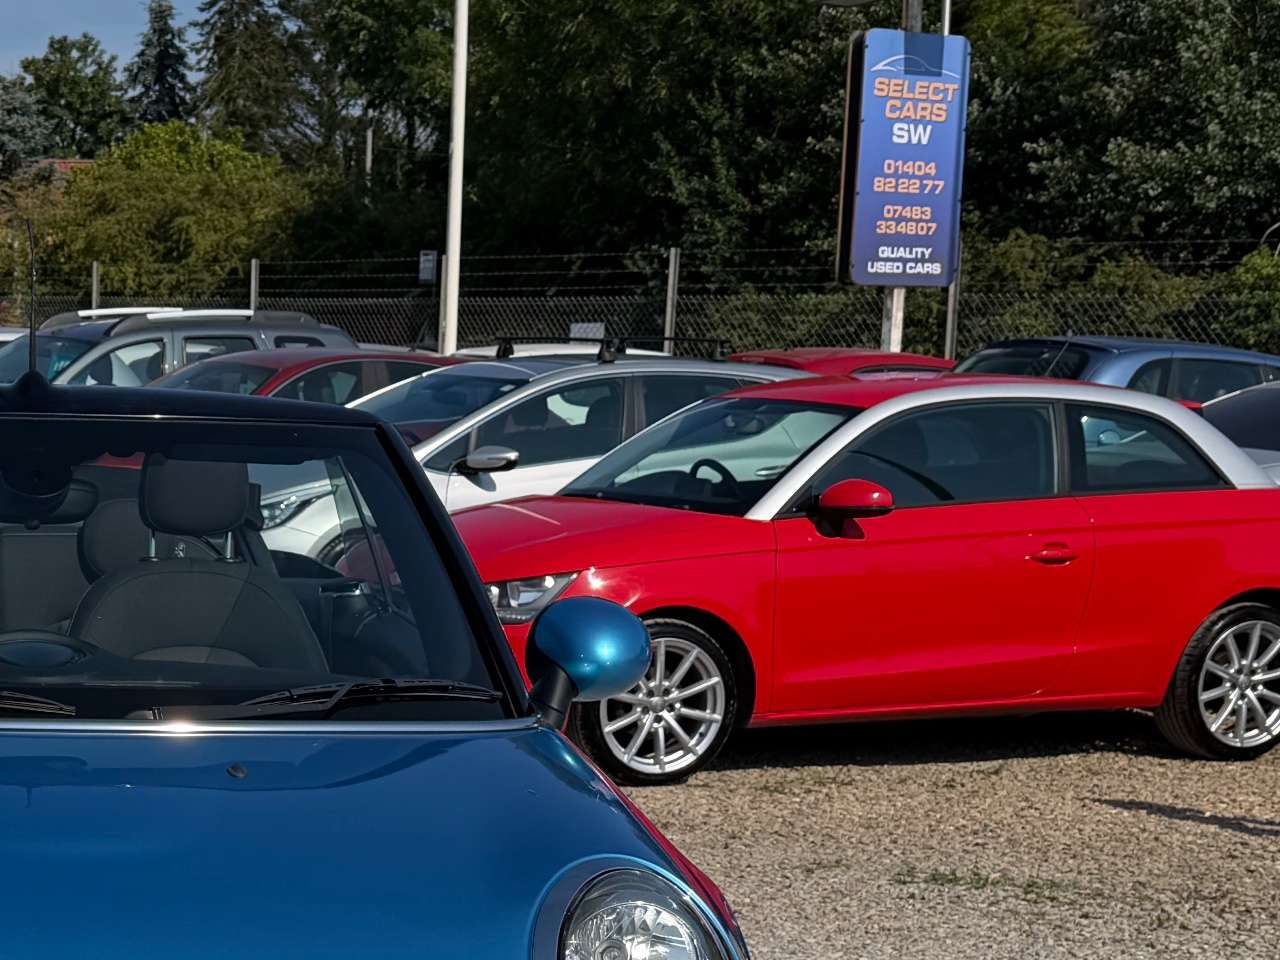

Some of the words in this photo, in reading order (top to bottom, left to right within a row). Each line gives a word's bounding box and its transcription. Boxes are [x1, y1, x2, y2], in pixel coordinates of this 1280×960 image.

[873, 77, 960, 101] SELECT
[885, 99, 948, 122] CARS
[892, 122, 933, 145] SW
[883, 159, 937, 176] 01404
[883, 205, 932, 220] 07483
[875, 220, 937, 235] 334807
[878, 246, 932, 259] QUALITY
[867, 261, 903, 273] USED
[906, 262, 942, 274] CARS
